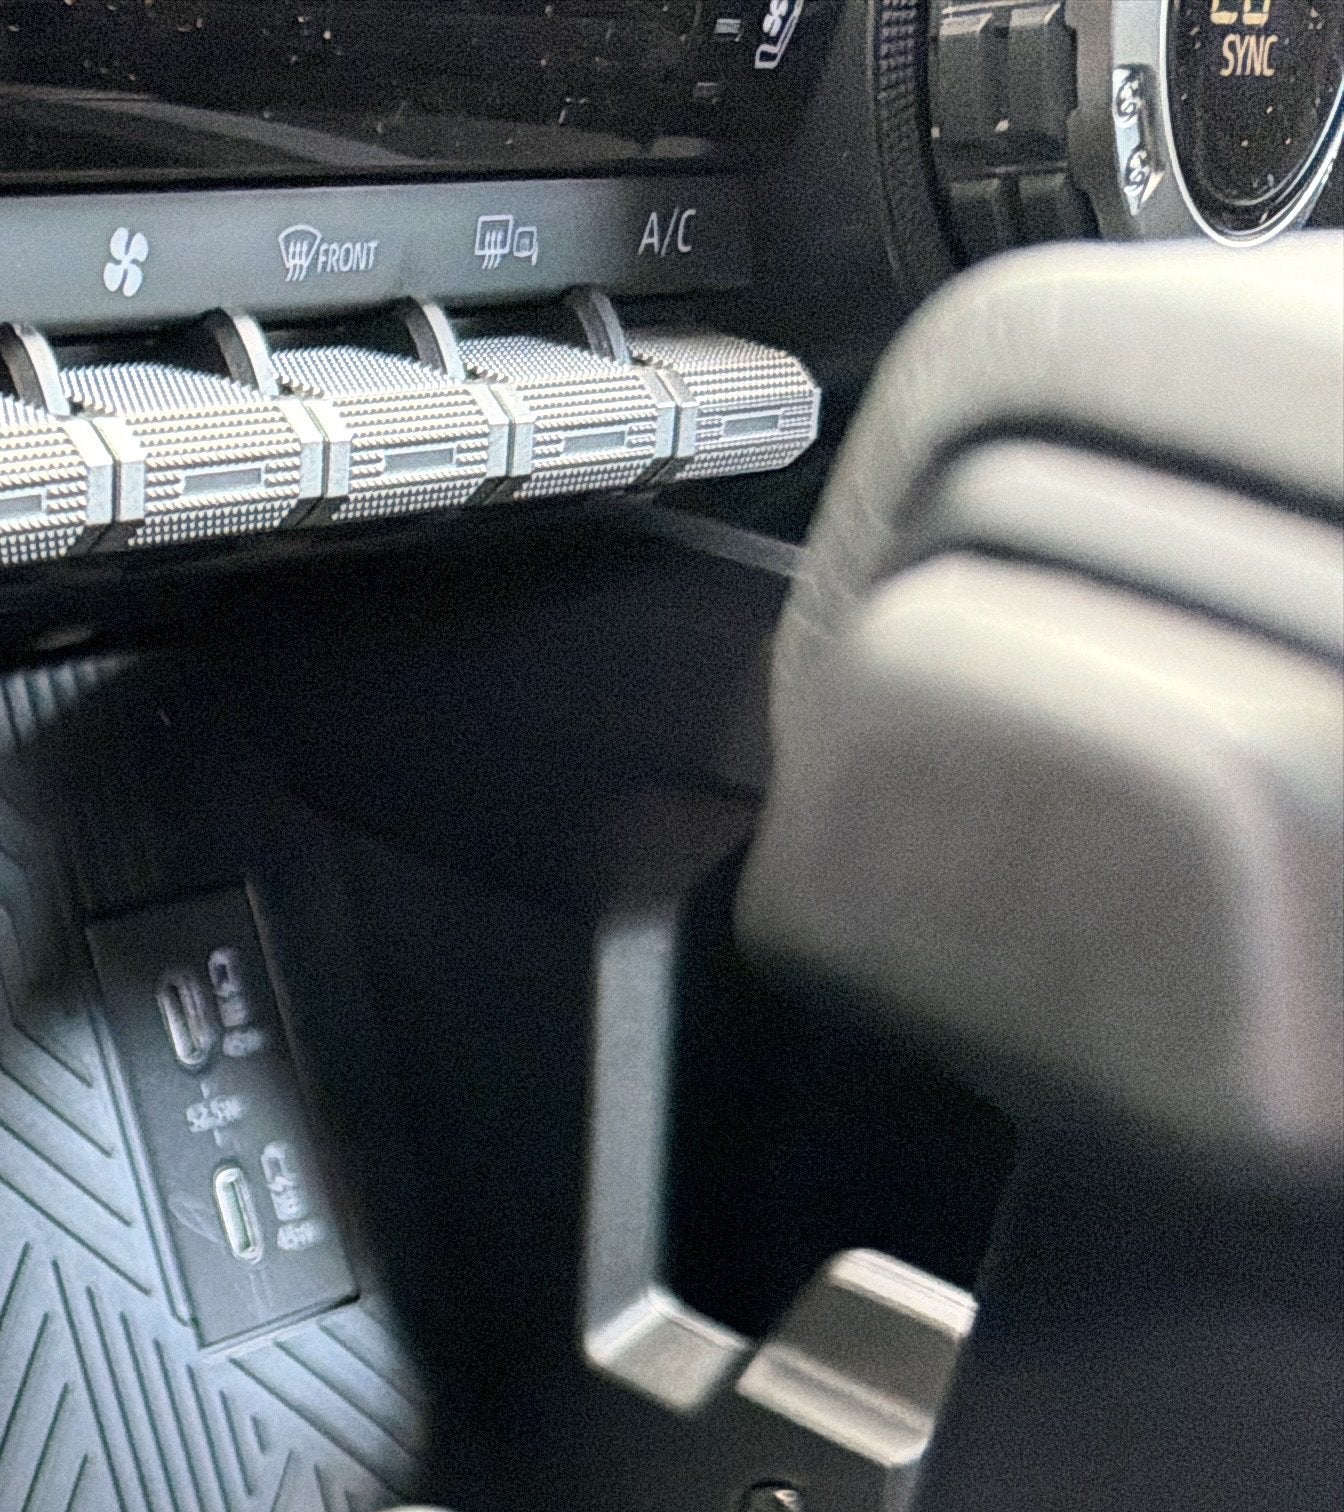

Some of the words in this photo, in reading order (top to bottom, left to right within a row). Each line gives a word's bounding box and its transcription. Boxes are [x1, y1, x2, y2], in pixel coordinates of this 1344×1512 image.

[1220, 33, 1278, 77] SYNC
[638, 208, 696, 255] A/C
[318, 241, 379, 273] FRONT
